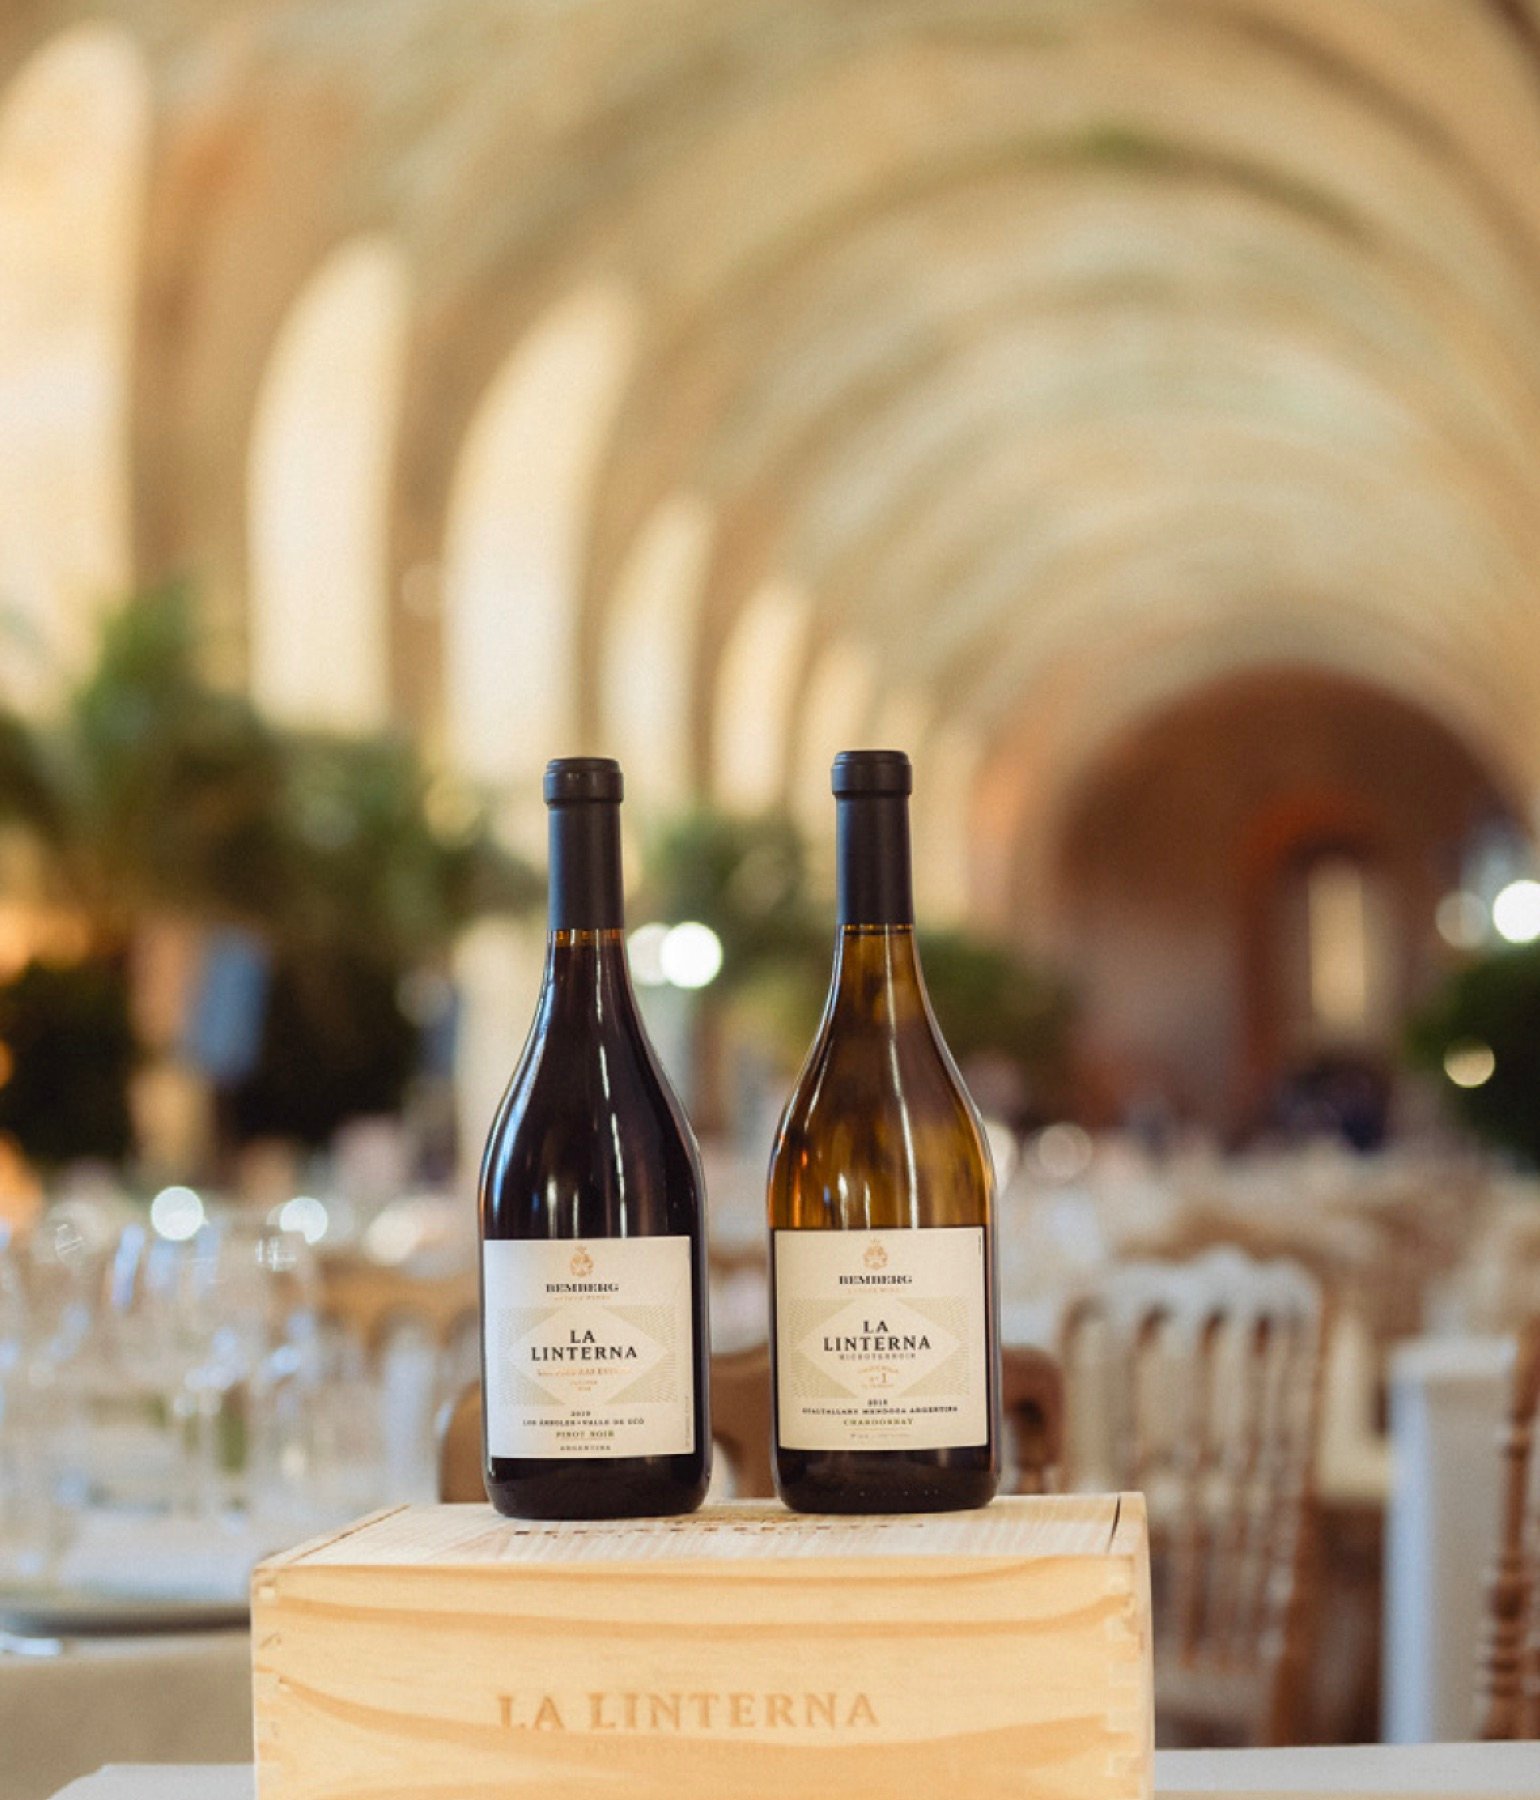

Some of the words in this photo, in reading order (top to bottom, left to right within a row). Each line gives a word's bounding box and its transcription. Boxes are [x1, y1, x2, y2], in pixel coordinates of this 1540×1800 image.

[863, 1320, 889, 1334] LA
[570, 1330, 595, 1344] LA
[823, 1335, 931, 1352] LINTERNA
[531, 1346, 637, 1362] LINTERNA
[498, 1695, 565, 1731] LA
[586, 1692, 880, 1731] LINTERNA
